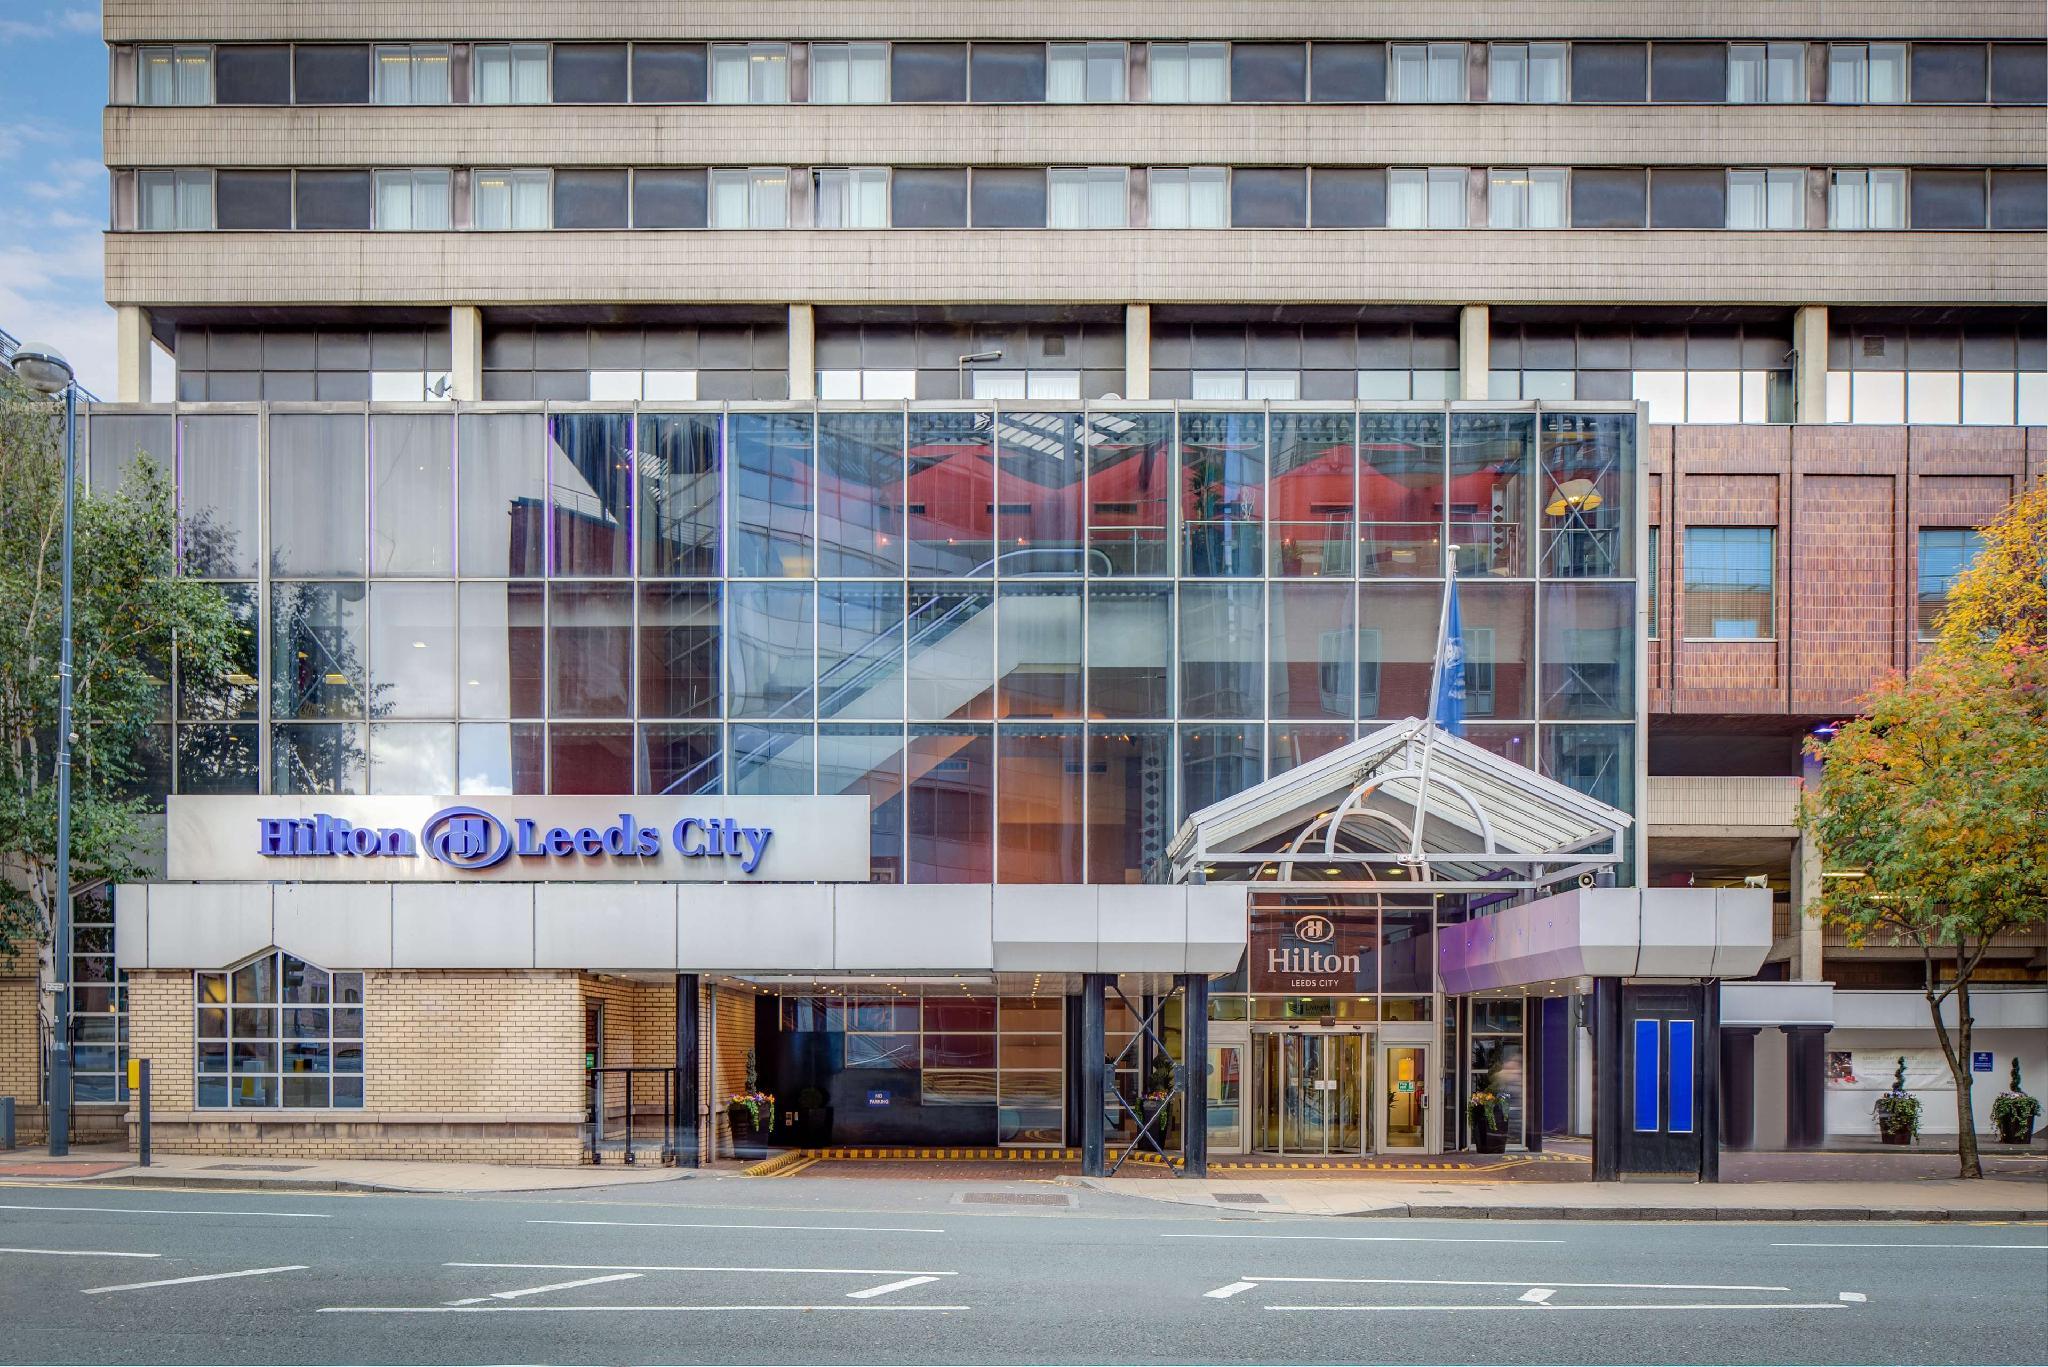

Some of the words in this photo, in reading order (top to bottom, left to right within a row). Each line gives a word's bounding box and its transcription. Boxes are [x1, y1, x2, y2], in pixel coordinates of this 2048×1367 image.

[257, 813, 418, 857] Hilton
[514, 813, 662, 857] Leeds
[672, 817, 773, 874] City
[1267, 947, 1361, 973] Hilton
[1291, 979, 1317, 987] LEEDS
[1318, 979, 1339, 987] CITY
